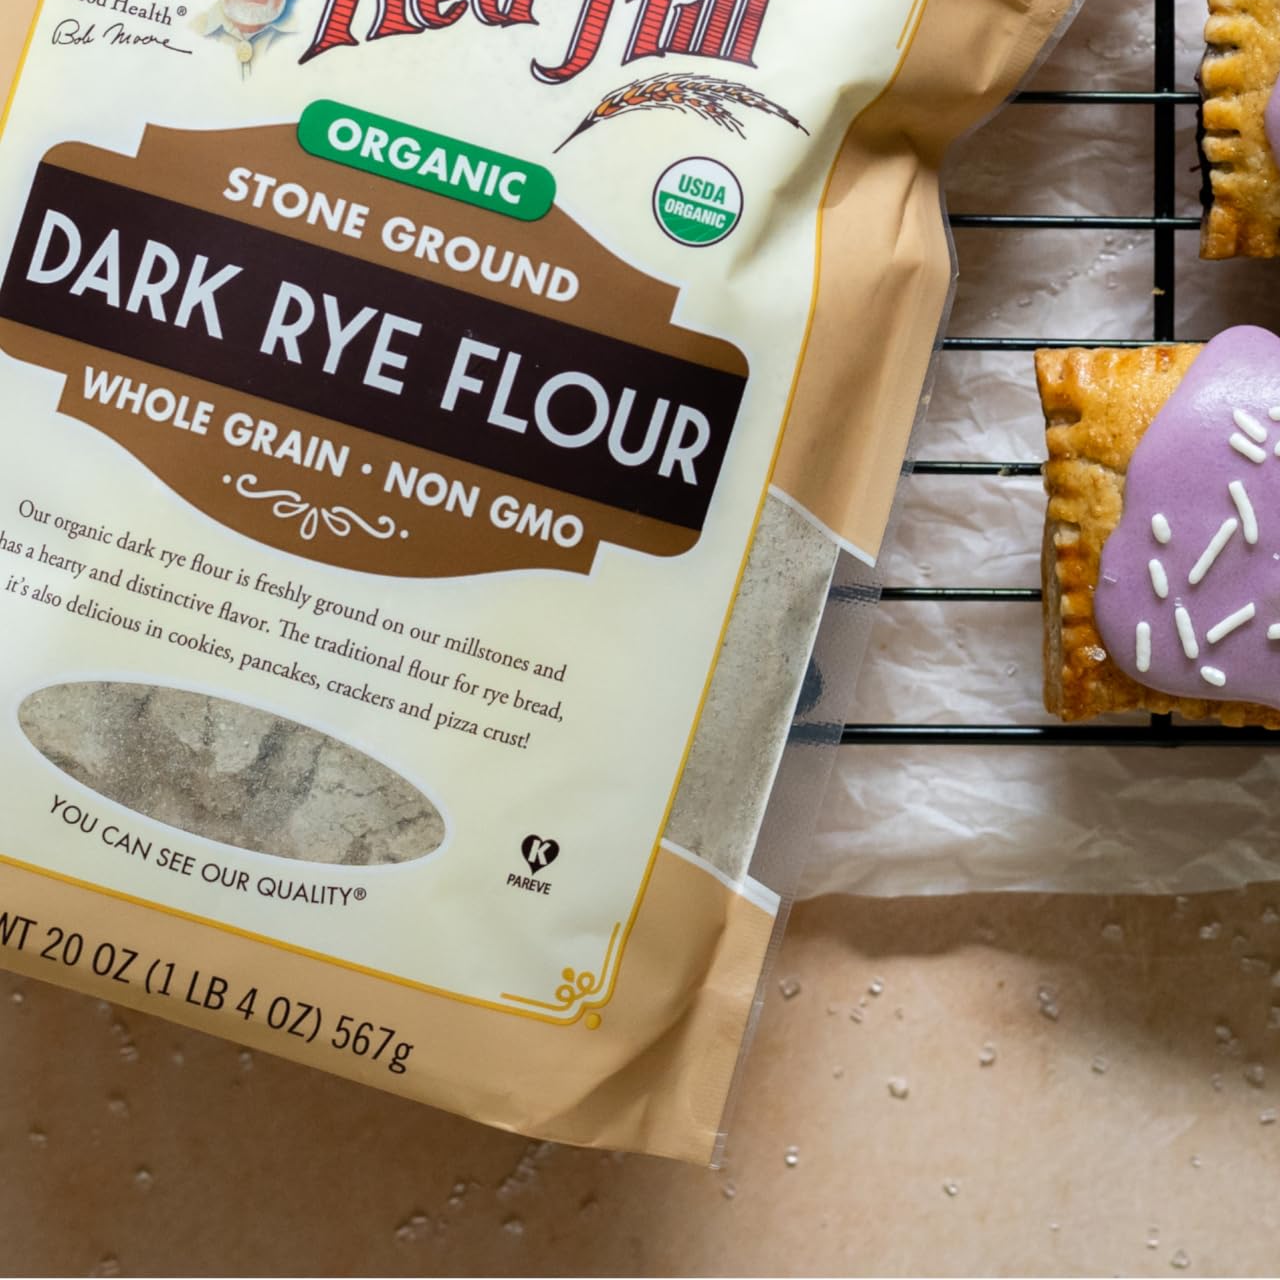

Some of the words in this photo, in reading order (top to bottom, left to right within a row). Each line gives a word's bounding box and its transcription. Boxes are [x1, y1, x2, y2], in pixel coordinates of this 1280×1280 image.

[52, 18, 96, 45] Bob
[327, 118, 527, 204] ORGANIC
[664, 197, 726, 229] ORGANIC
[678, 173, 726, 205] USDA
[222, 167, 370, 239] STONE
[381, 217, 579, 302] GROUND
[25, 208, 244, 340] DARK
[260, 280, 422, 396] RYE
[440, 336, 711, 486] FLOUR
[83, 366, 215, 435] WHOLE
[223, 412, 350, 477] GRAIN
[383, 461, 480, 518] NON
[490, 495, 584, 548] GMO
[0, 530, 23, 554] has
[25, 547, 35, 559] a
[38, 544, 87, 579] hearty
[88, 567, 123, 588] and
[126, 574, 214, 616] distinctive
[217, 601, 271, 634] flavor.
[278, 618, 310, 645] The
[314, 633, 405, 674] traditional
[407, 658, 450, 688] flour
[453, 673, 480, 696] for
[482, 688, 509, 707] rye
[513, 690, 564, 722] bread,
[18, 499, 51, 525] Our
[54, 516, 113, 544] organic
[116, 532, 156, 558] dark
[160, 549, 187, 569] rye
[190, 553, 233, 582] flour
[235, 570, 250, 587] is
[254, 572, 312, 610] freshly
[313, 596, 380, 627] ground
[382, 618, 404, 635] on
[409, 626, 441, 645] our
[444, 636, 530, 671] millstones
[533, 664, 567, 683] and
[31, 585, 62, 607] also
[66, 595, 142, 632] delicious
[145, 619, 163, 640] in
[168, 631, 235, 663] cookies,
[238, 652, 320, 690] pancakes,
[326, 679, 395, 710] crackers
[398, 703, 433, 722] and
[433, 711, 478, 735] pizza
[483, 727, 531, 750] crust!
[50, 795, 98, 833] YOU
[101, 825, 152, 861] CAN
[155, 847, 196, 876] SEE
[201, 863, 250, 892] OUR
[507, 873, 552, 895] PAREVE
[40, 927, 84, 966] 20
[92, 943, 138, 984] OZ
[144, 958, 177, 996] (1
[185, 971, 229, 1010] LB
[236, 988, 258, 1020] 4
[266, 996, 322, 1043] OZ)
[331, 1015, 414, 1074] 567g
